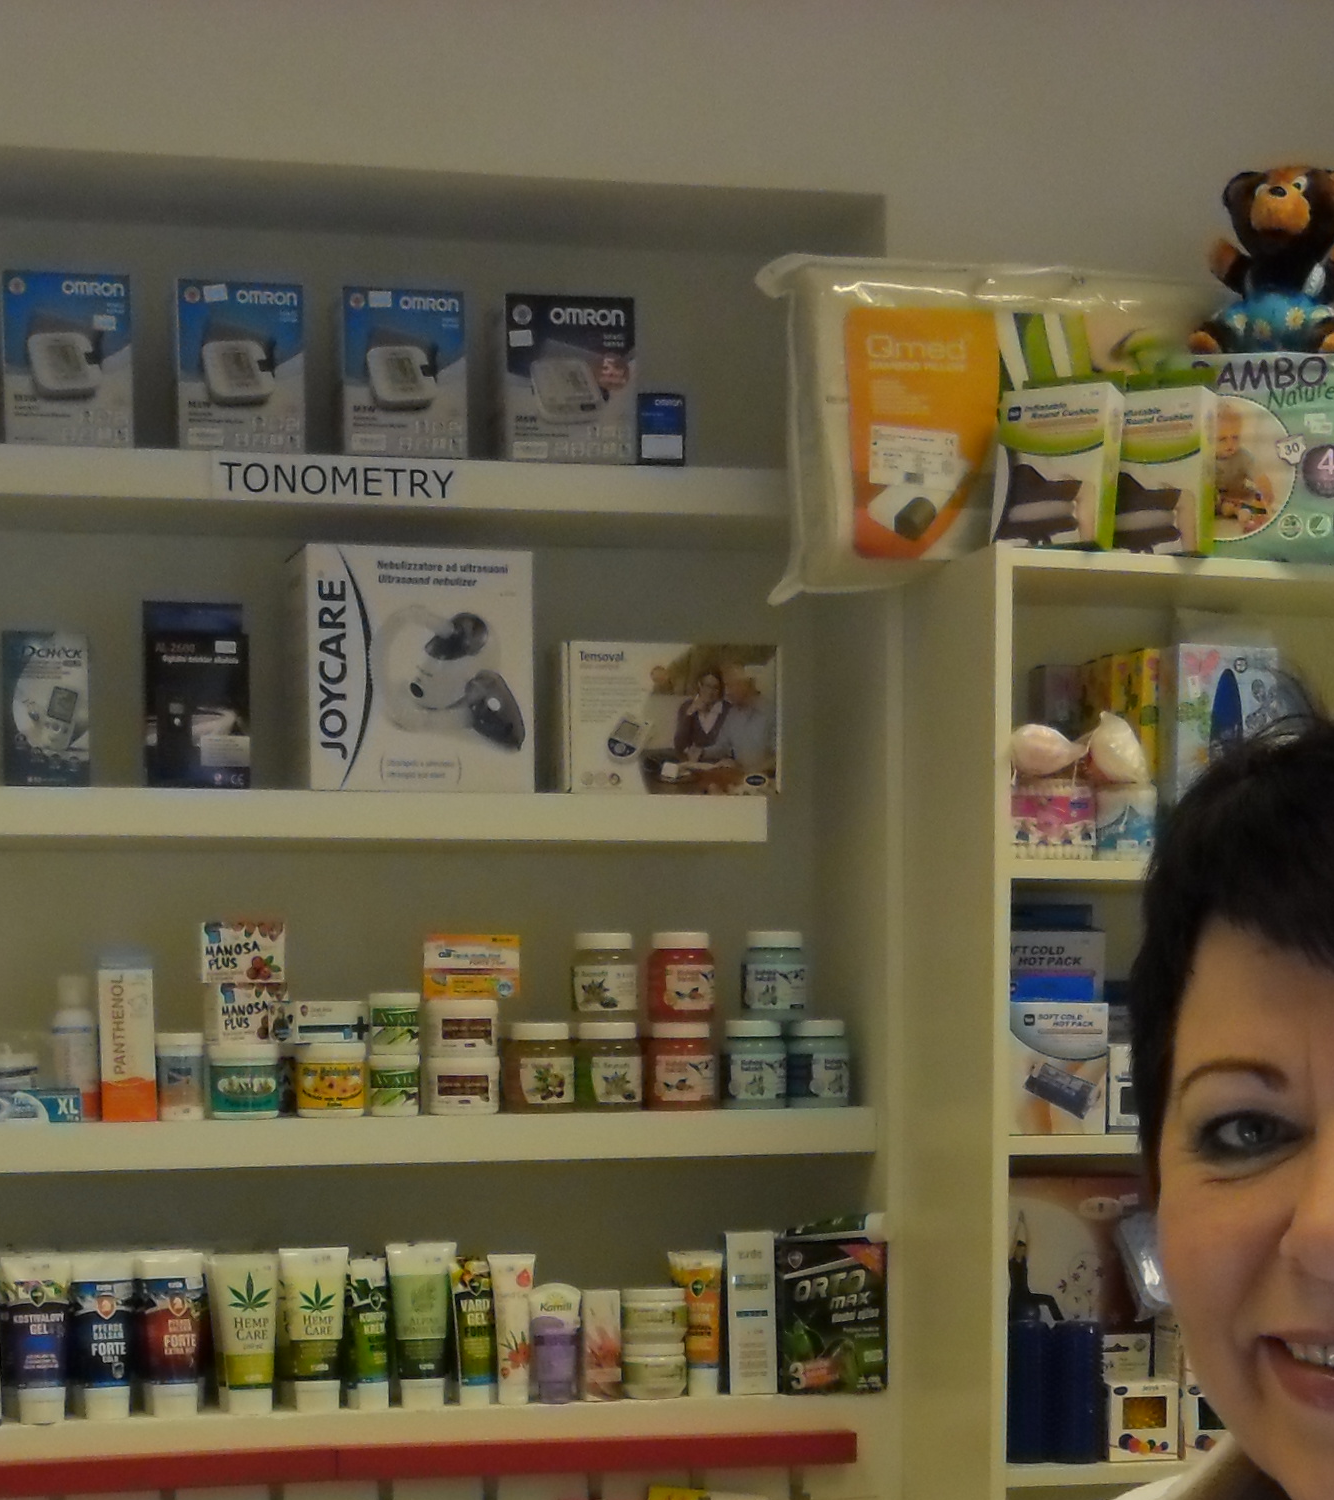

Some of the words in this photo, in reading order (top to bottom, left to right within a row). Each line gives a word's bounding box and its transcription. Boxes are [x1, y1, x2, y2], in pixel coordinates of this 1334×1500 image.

[61, 280, 125, 298] OMRON
[236, 287, 298, 307] OMRON
[398, 294, 460, 313] OMRON
[549, 307, 625, 328] OMRON
[218, 460, 454, 500] TONOMETRY
[377, 559, 444, 574] Nebulizzatore
[446, 562, 458, 574] ad
[377, 575, 431, 586] Ultrasound
[433, 576, 478, 588] nebulizer
[578, 649, 625, 663] Tensoval
[317, 579, 347, 760] JOYCARE
[205, 941, 261, 957] MANOSA
[1030, 945, 1065, 955] COLD
[208, 957, 237, 971] PLUS
[1018, 956, 1044, 966] HOT
[1046, 956, 1082, 966] PACK
[221, 1001, 269, 1017] MANOSA
[113, 973, 126, 1076] PANTHENOL
[224, 1016, 250, 1030] PLUS
[56, 1096, 78, 1115] XL
[794, 1267, 867, 1302] ORTO
[539, 1301, 572, 1312] Kamill
[233, 1316, 270, 1329] HEMP
[302, 1314, 334, 1326] HEMP
[236, 1329, 268, 1341] CARE
[304, 1325, 334, 1337] CARE
[90, 1341, 127, 1356] FORTE
[163, 1334, 197, 1348] FORTE
[789, 1361, 806, 1390] 3
